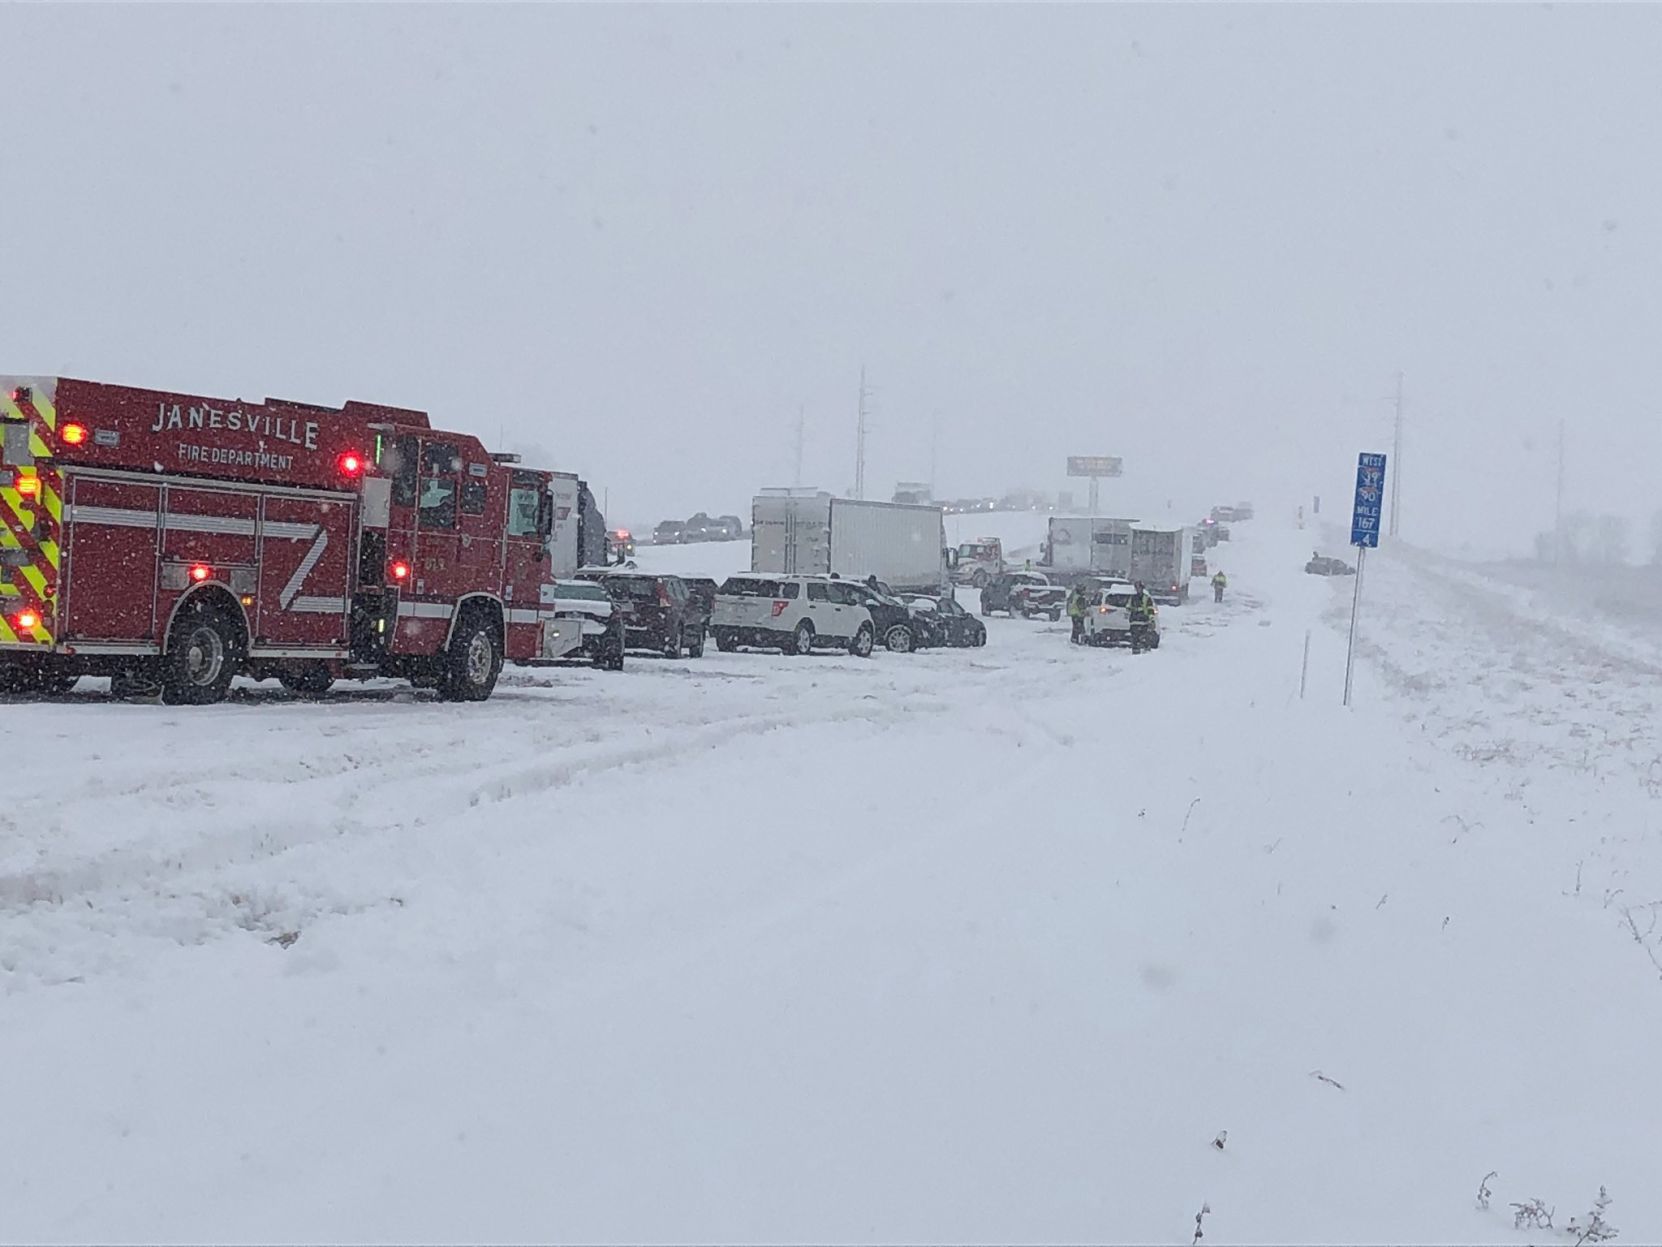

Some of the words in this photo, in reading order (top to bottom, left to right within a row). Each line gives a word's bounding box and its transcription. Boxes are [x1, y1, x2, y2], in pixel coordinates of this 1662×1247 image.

[152, 403, 319, 449] JANESVILLE
[178, 444, 208, 461] FIRE
[212, 448, 294, 470] DEPARTMENT
[1362, 455, 1383, 467] WEST
[1366, 471, 1379, 481] 39
[1361, 491, 1376, 501] 90
[1357, 506, 1379, 516] MILE
[1357, 517, 1375, 529] 167
